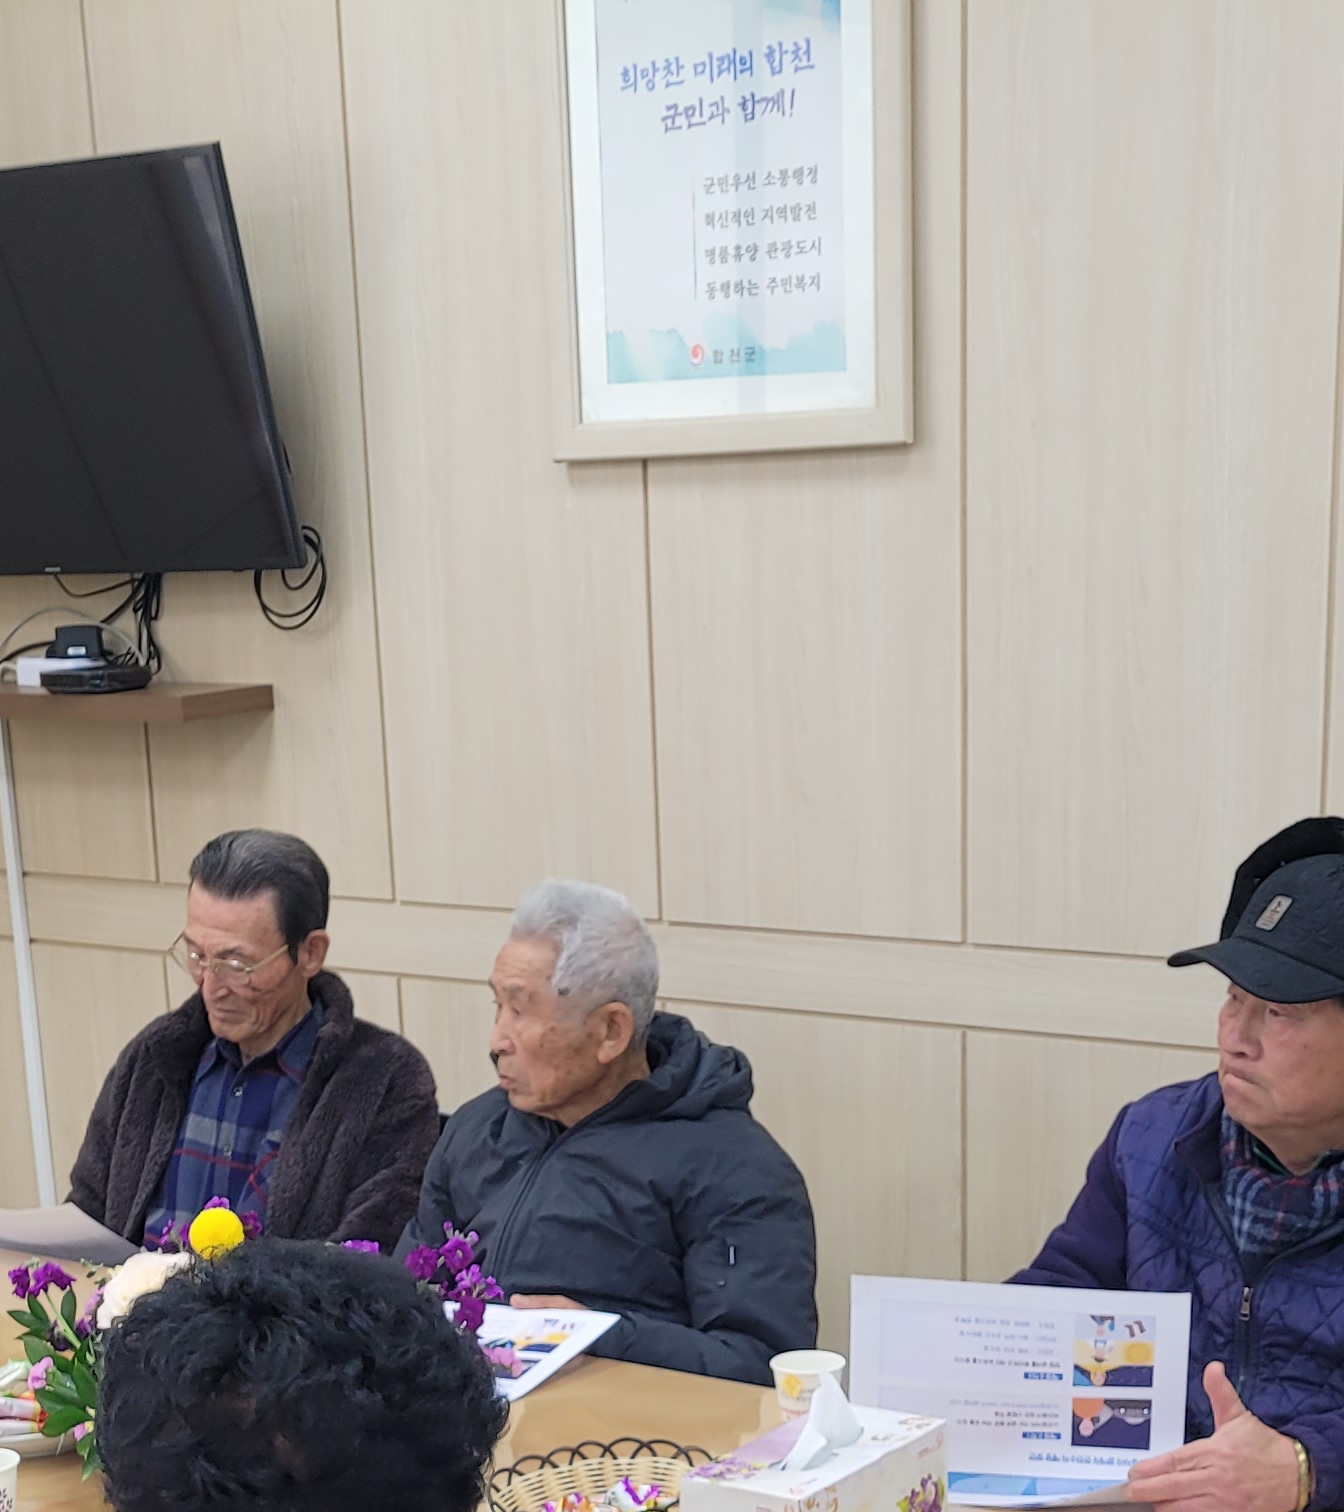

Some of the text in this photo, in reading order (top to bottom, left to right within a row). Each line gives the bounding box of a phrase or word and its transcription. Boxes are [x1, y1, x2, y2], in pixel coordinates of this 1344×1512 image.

[621, 38, 815, 94] 희망찬 미래의 합천
[661, 88, 795, 133] 군민과 함께!
[762, 201, 817, 224] 지역발전
[766, 237, 821, 259] 관광도시
[766, 272, 820, 295] 주민복지
